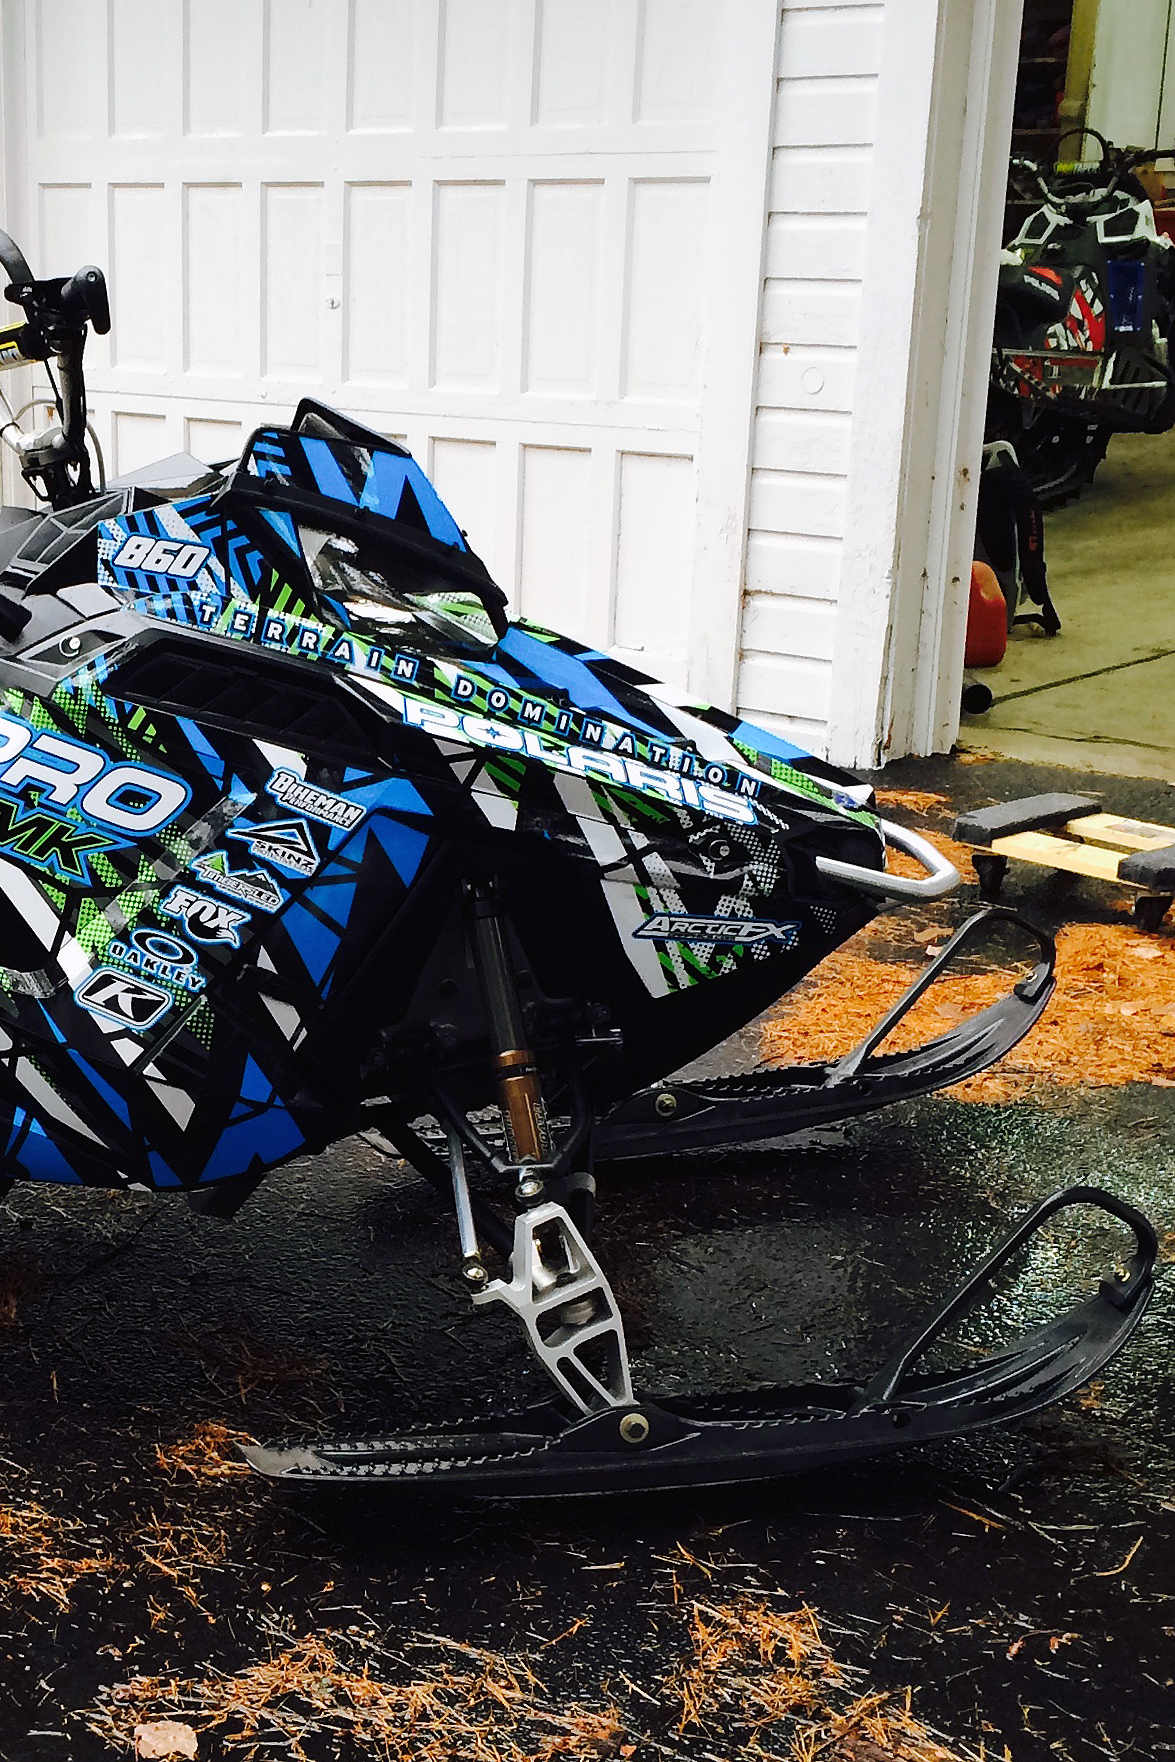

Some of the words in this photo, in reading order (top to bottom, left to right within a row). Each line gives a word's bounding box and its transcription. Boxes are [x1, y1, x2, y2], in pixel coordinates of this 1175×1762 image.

[113, 535, 210, 578] 860
[201, 604, 415, 679] TERRAIN
[456, 678, 761, 797] DOMINATION
[403, 696, 759, 825] POLARIS
[255, 840, 315, 869] SKINZ
[162, 888, 246, 931] FOX
[111, 943, 203, 989] OAKLEY
